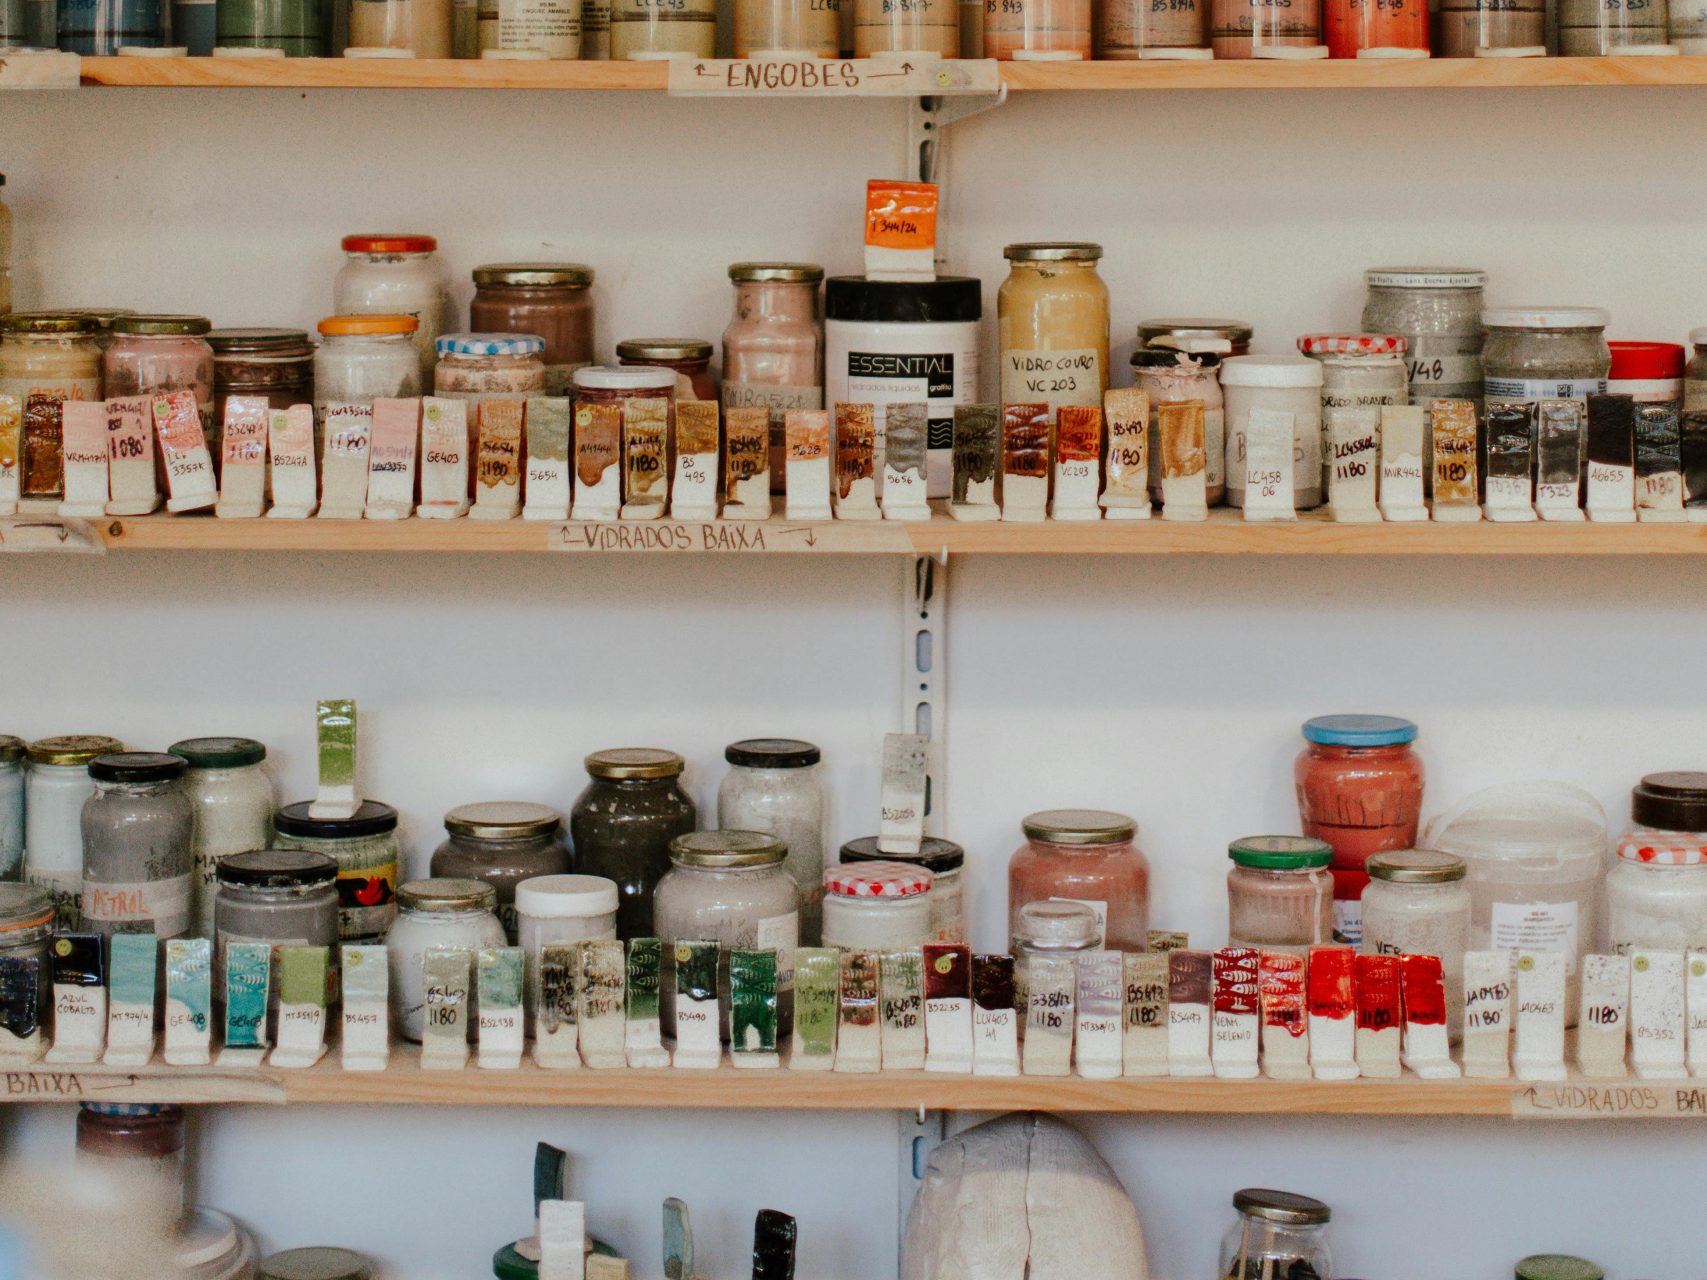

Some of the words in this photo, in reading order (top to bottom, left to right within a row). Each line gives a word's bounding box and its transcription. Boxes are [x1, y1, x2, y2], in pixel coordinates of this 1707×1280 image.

[727, 62, 860, 89] ENGOBES
[850, 354, 953, 375] ESSENTIAL
[56, 1004, 97, 1016] COBALTO
